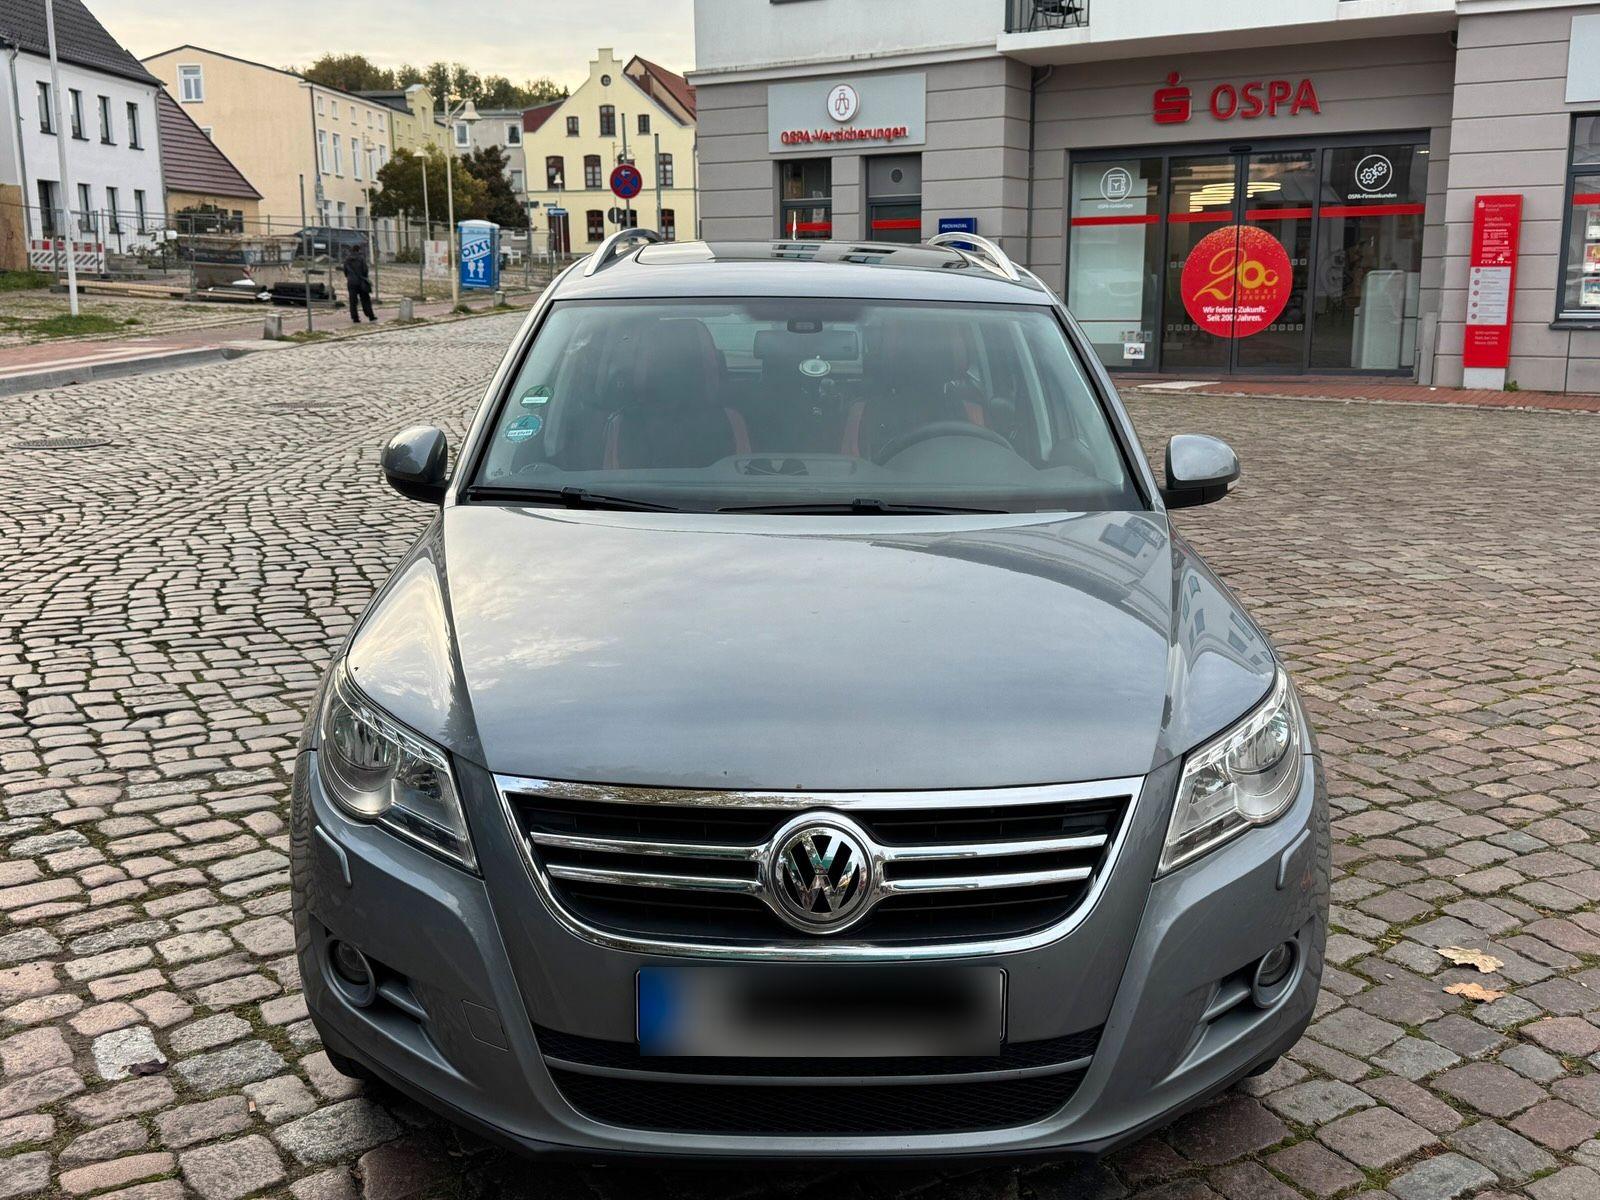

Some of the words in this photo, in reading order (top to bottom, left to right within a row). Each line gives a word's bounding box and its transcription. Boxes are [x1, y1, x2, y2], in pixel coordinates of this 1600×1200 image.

[1209, 78, 1321, 121] OSPA
[780, 125, 908, 145] OSPA-Versicherungen
[462, 239, 490, 258] DIXI
[776, 827, 867, 918] VW
